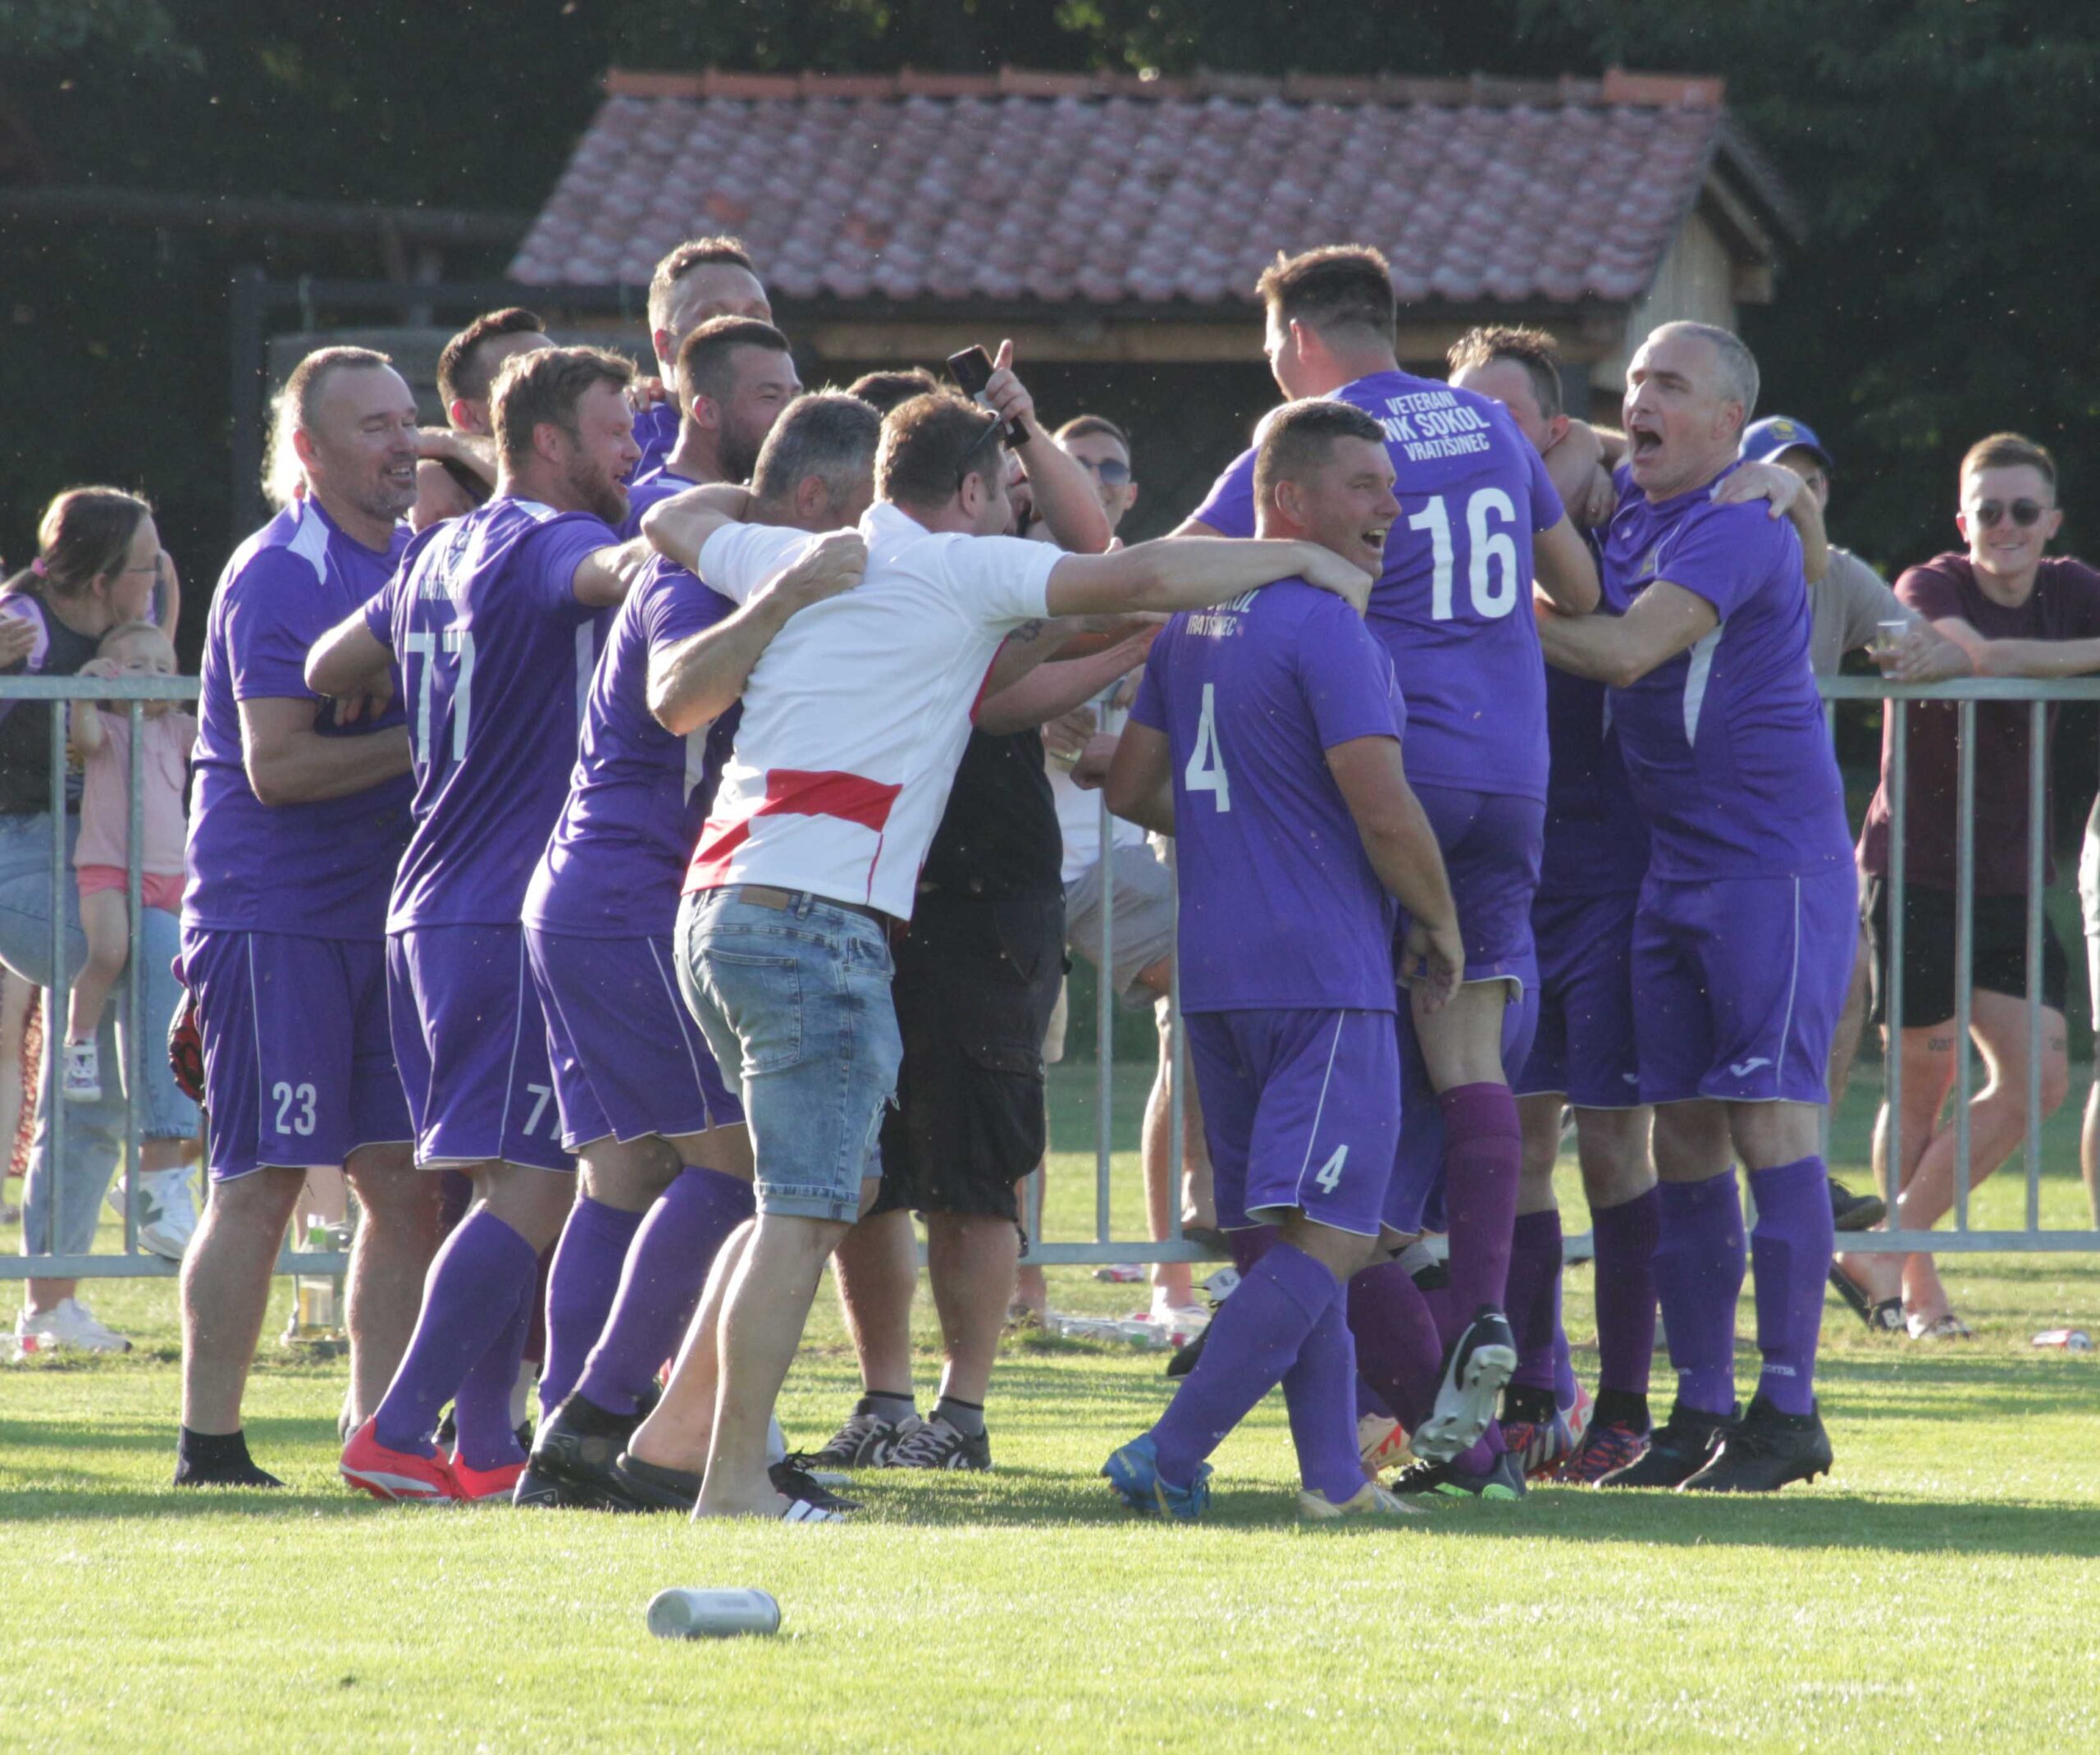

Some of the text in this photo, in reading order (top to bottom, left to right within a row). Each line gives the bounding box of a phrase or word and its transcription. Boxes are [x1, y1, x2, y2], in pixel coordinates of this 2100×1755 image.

[1385, 391, 1458, 415] VETERANI
[1385, 406, 1491, 442] NK SOKOL
[1404, 432, 1491, 462] VRATIŠINEC
[1408, 487, 1517, 620] 16
[404, 631, 476, 762] 77
[1185, 683, 1230, 812] 4
[272, 1081, 317, 1136] 23
[1315, 1144, 1349, 1195] 4
